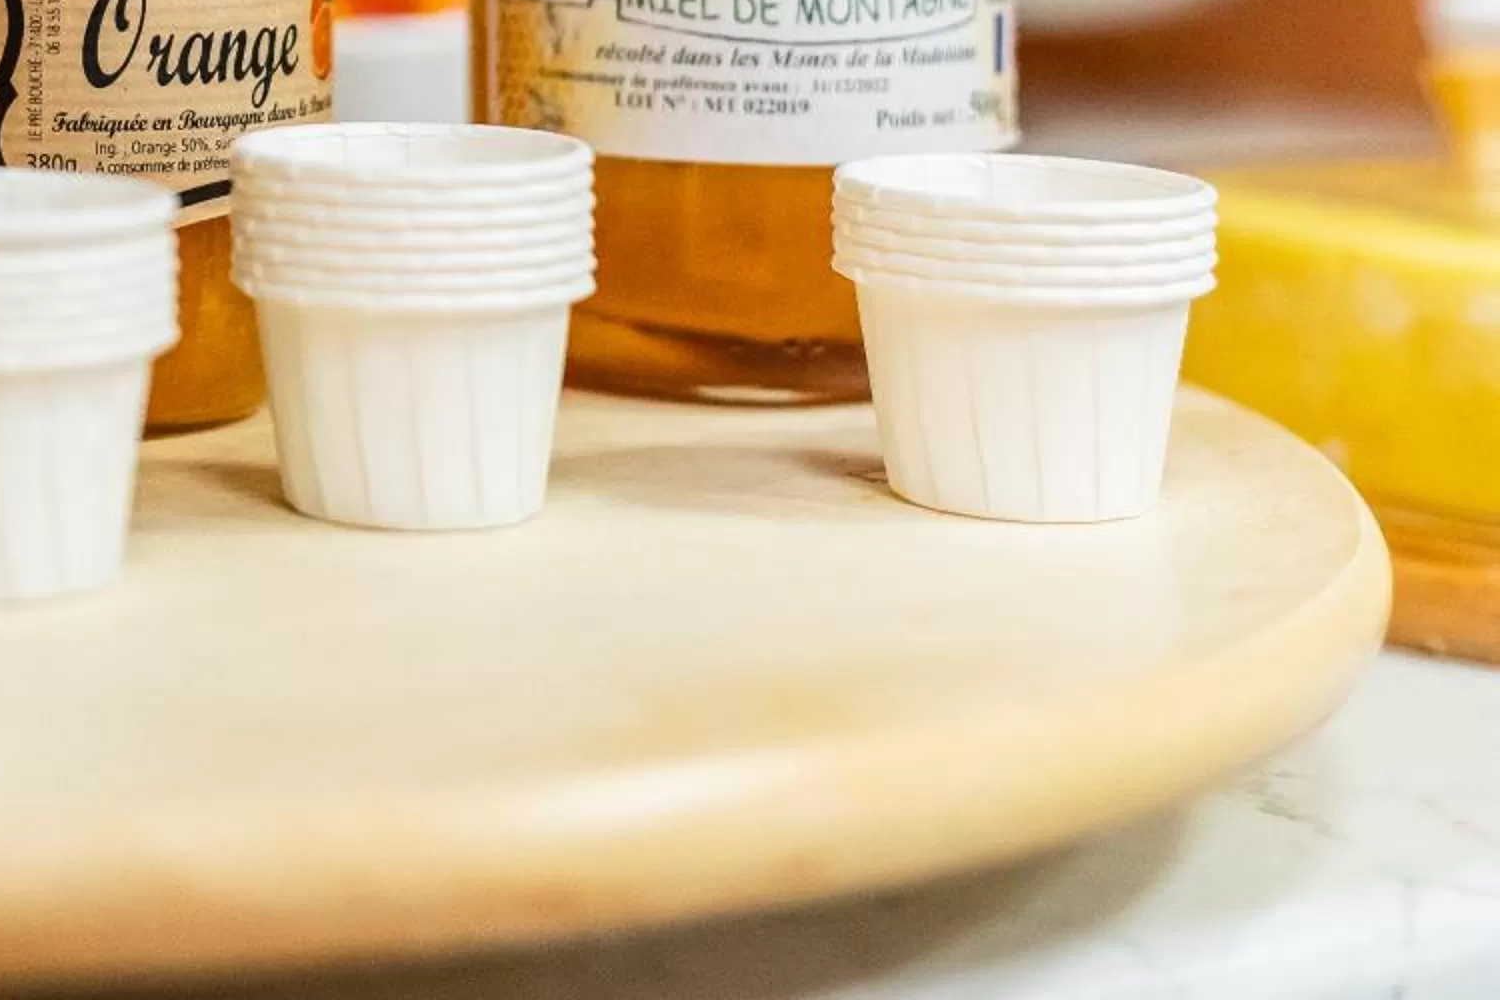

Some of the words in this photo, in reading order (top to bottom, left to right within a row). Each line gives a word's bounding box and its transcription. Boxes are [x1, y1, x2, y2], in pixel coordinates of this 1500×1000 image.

[48, 42, 60, 55] 06
[595, 42, 665, 66] récolté
[671, 44, 724, 66] dans
[729, 45, 761, 70] les
[770, 48, 839, 71] Monts
[844, 48, 868, 69] de
[874, 47, 894, 68] la
[52, 110, 148, 137] Fabriquée
[151, 118, 173, 133] en
[177, 107, 265, 134] Bourgogne
[875, 108, 927, 130] Poids
[131, 140, 178, 157] Orange
[107, 161, 174, 174] consommer
[177, 157, 191, 172] de
